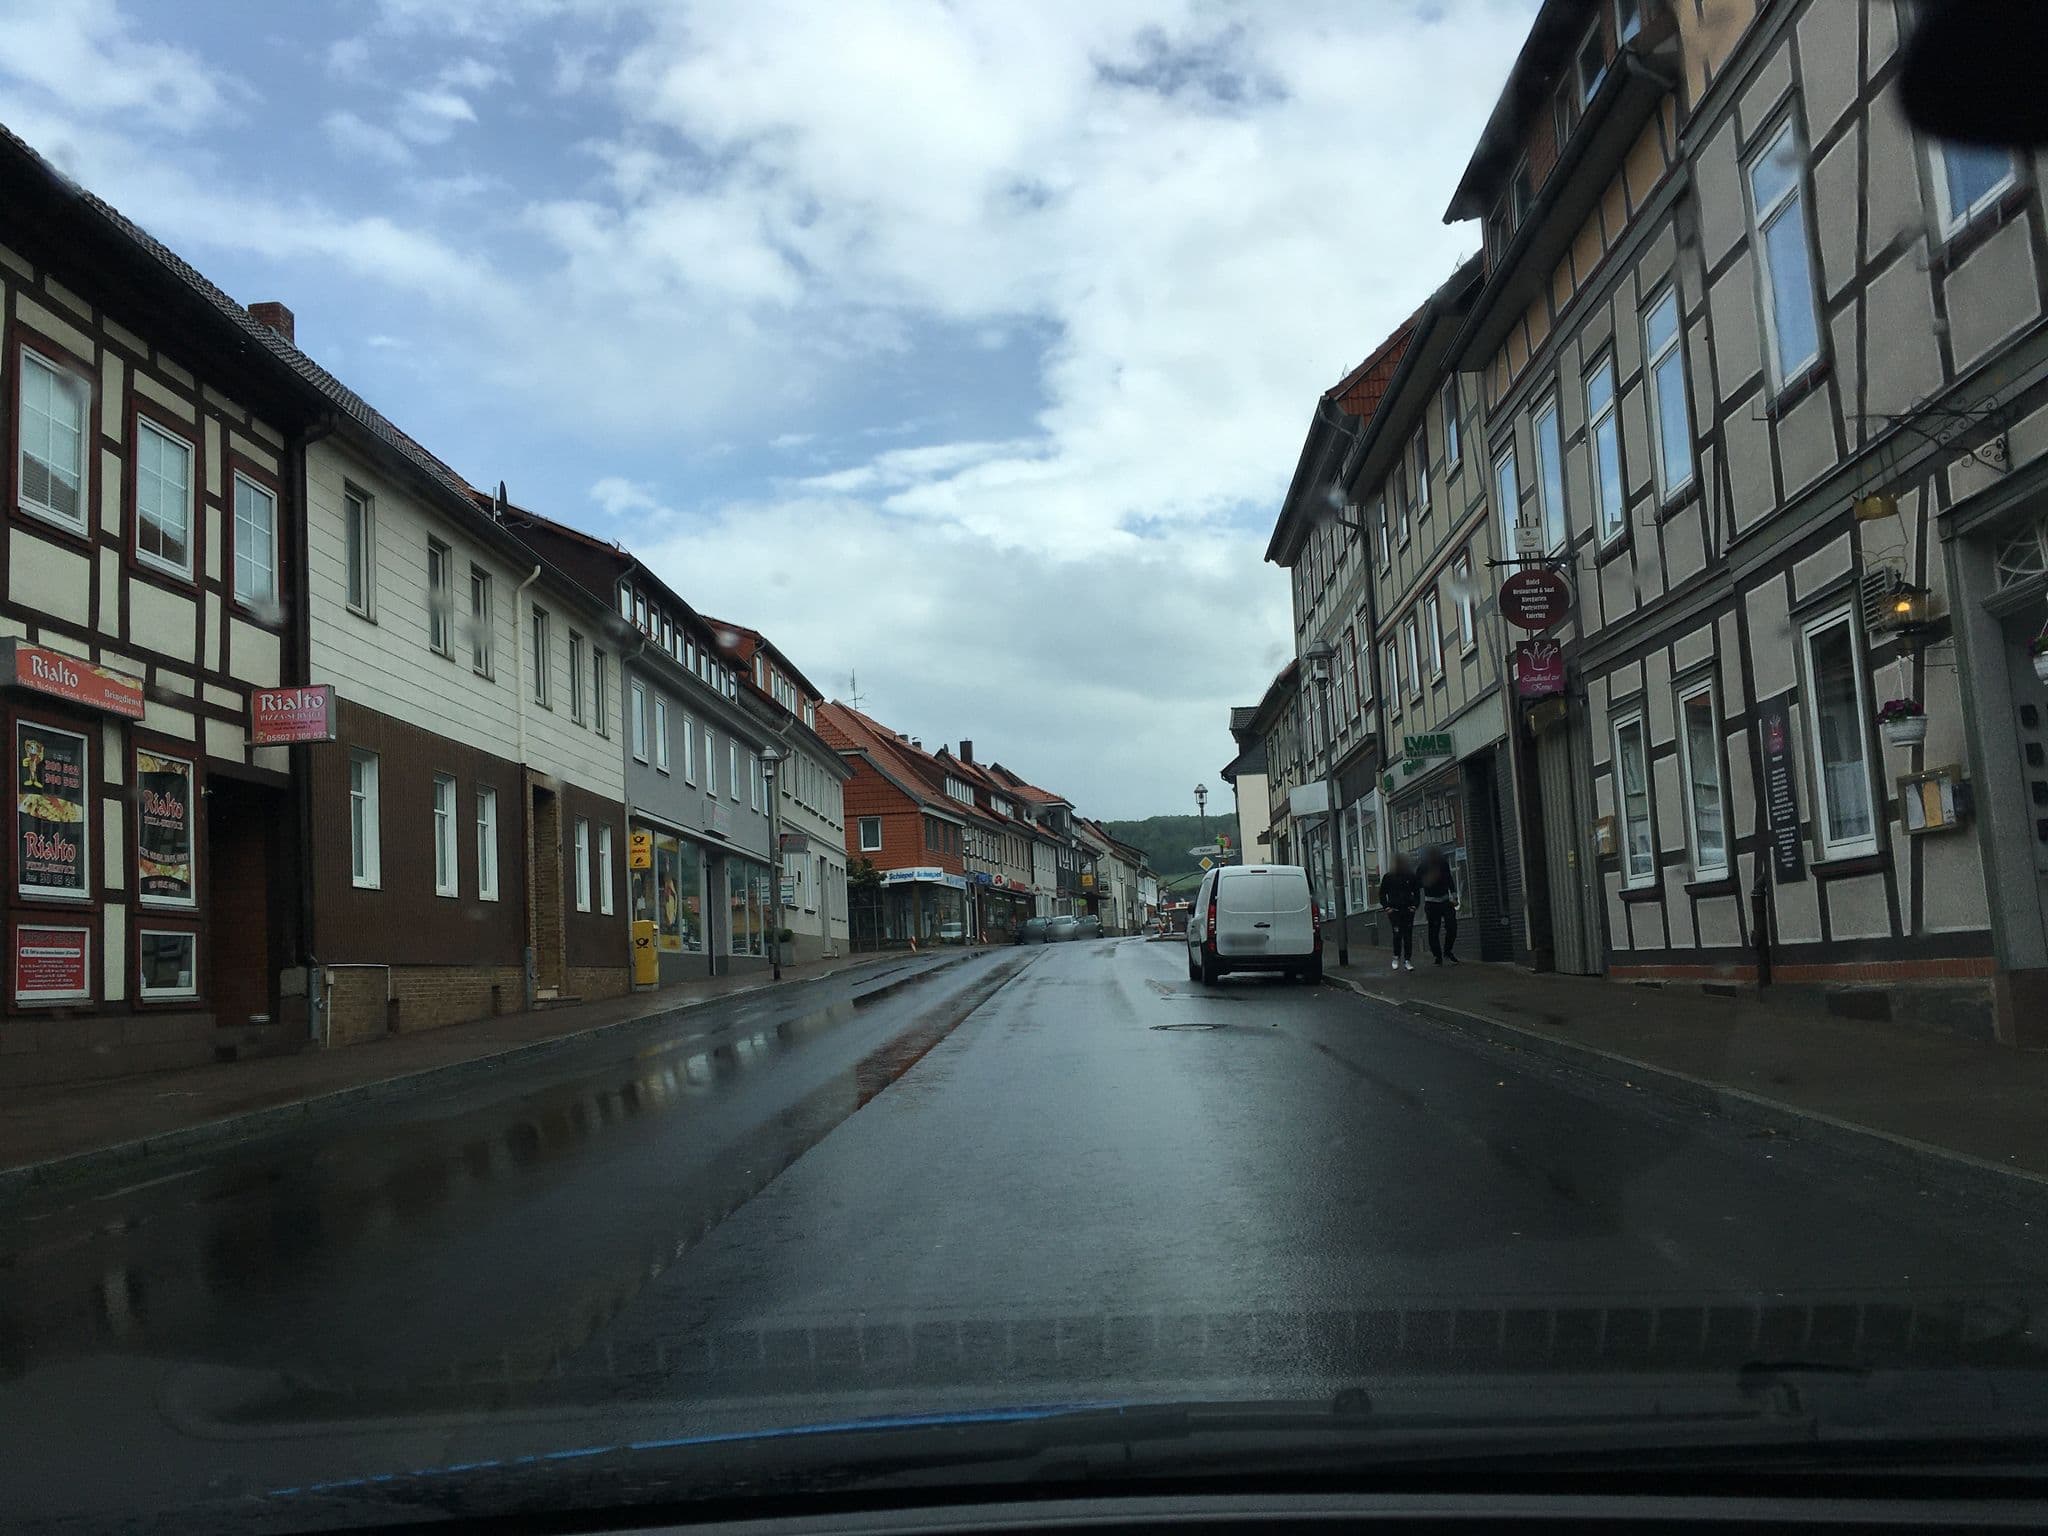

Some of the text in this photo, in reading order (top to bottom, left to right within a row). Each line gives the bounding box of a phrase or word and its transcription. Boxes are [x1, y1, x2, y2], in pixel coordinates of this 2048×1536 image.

[30, 655, 80, 688] Rialto
[104, 688, 142, 708] Bringdienst
[259, 689, 324, 712] Rialto
[266, 734, 290, 742] 05502
[1404, 734, 1436, 751] LVM
[143, 789, 184, 820] Rialto
[24, 831, 77, 863] Rialto
